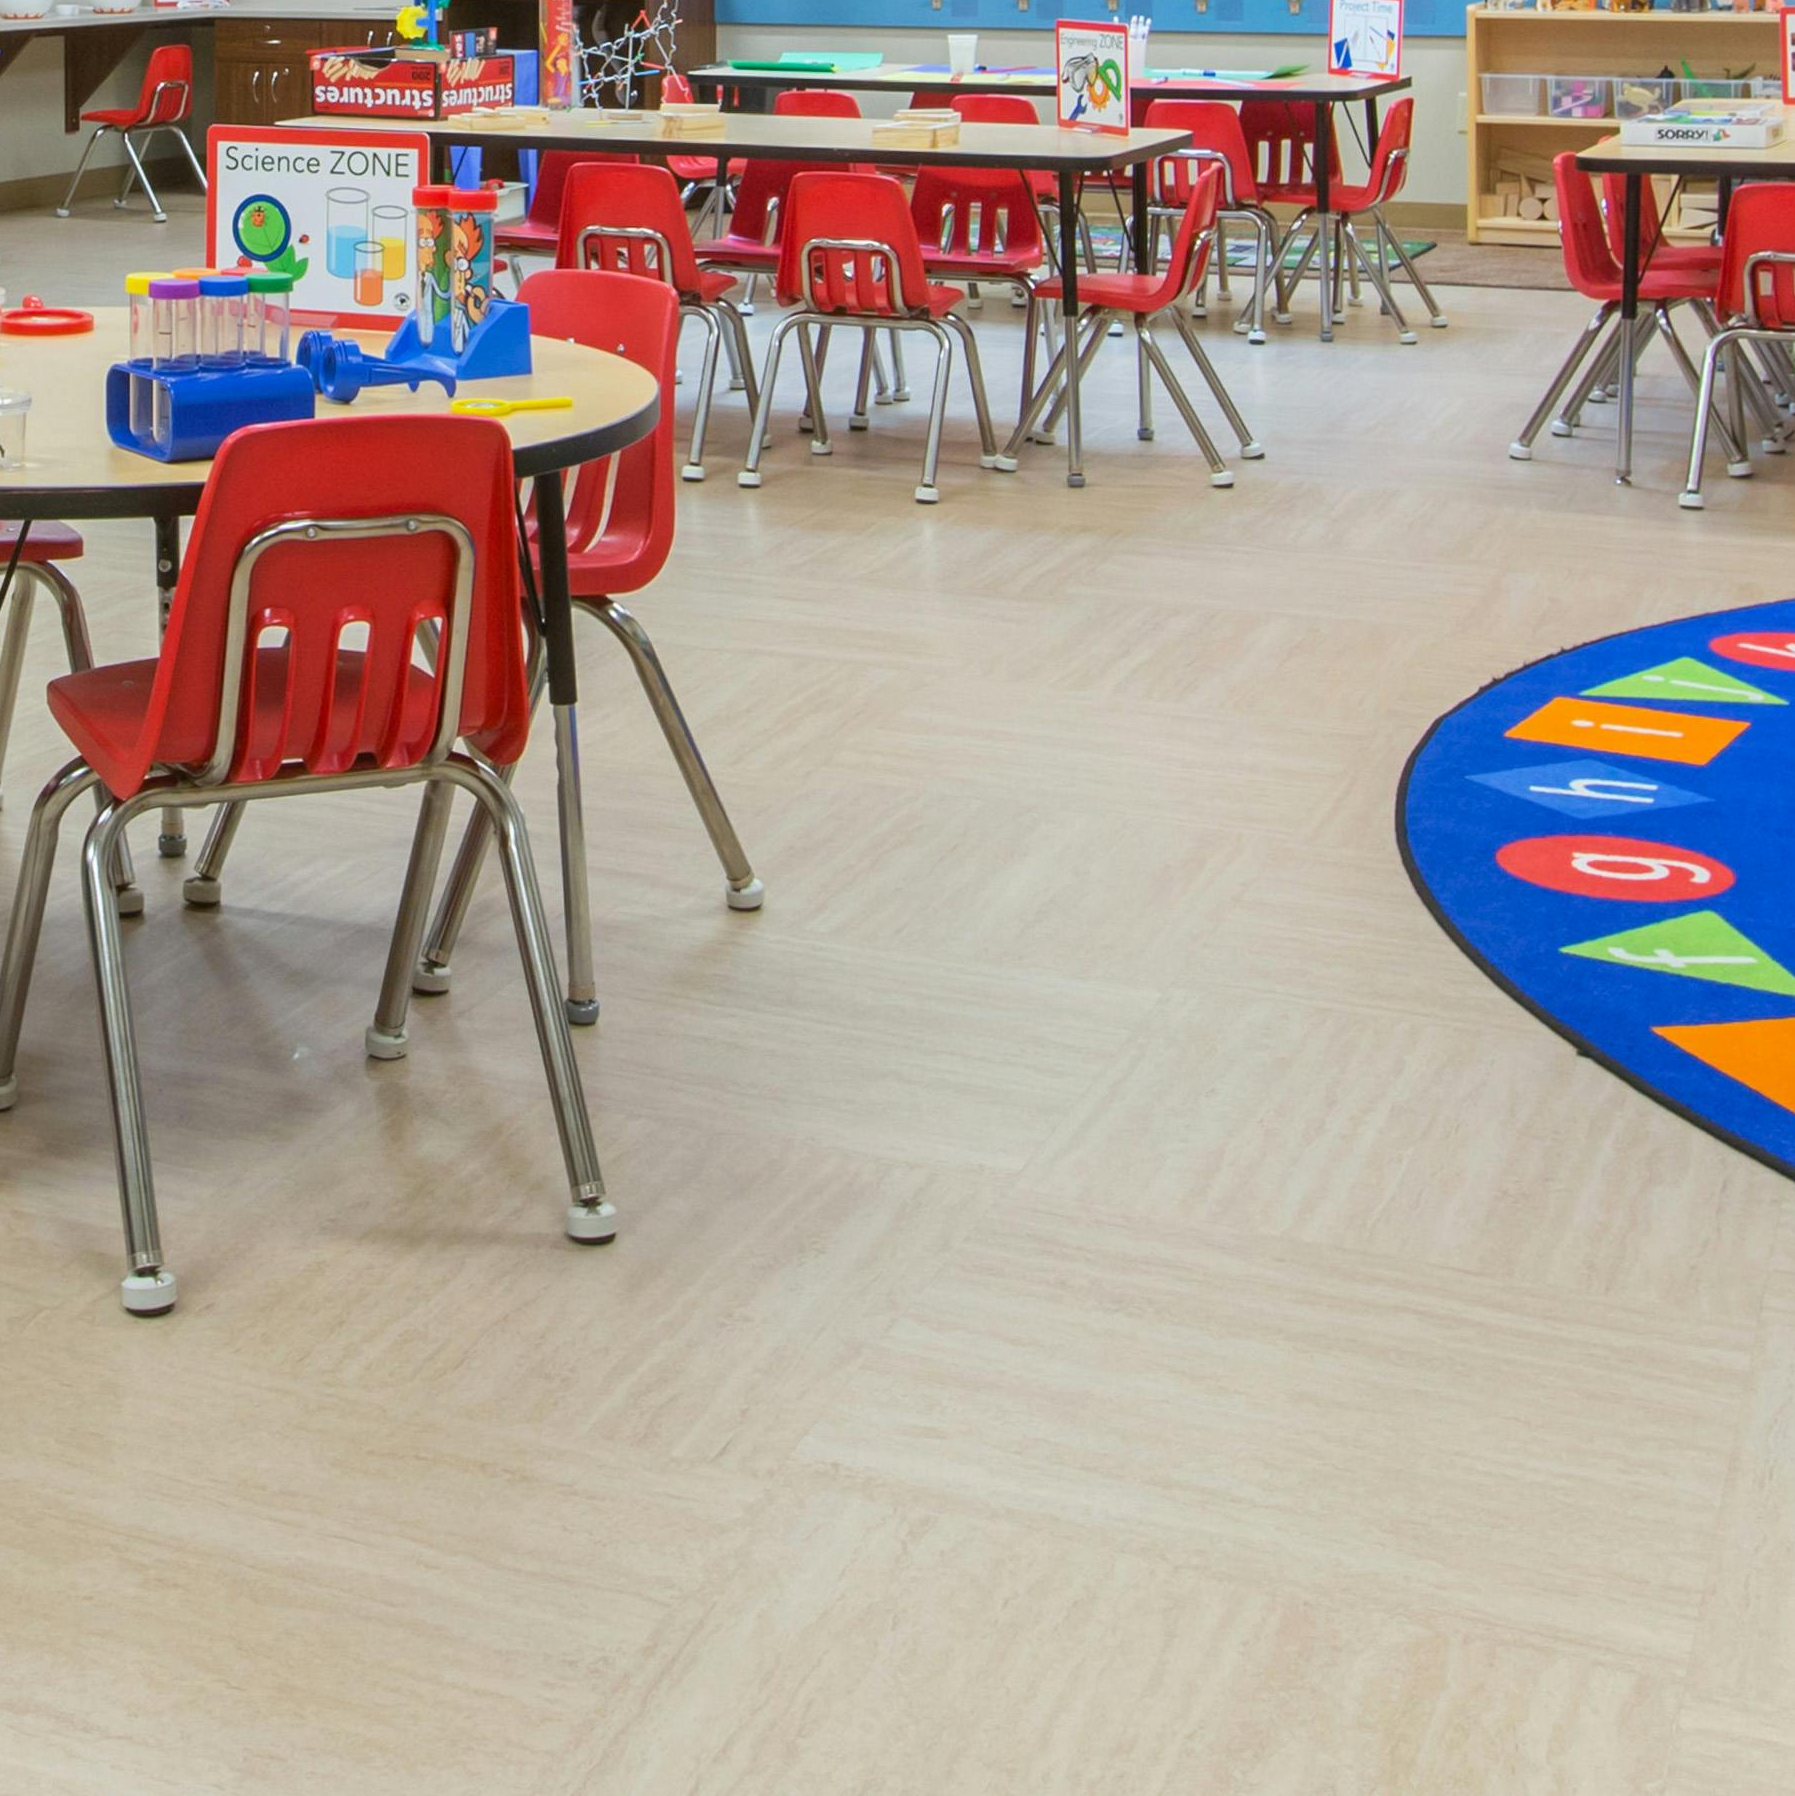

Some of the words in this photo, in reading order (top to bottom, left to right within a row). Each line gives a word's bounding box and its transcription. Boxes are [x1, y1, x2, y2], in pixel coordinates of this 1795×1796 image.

[1339, 0, 1369, 13] Project
[1372, 1, 1393, 13] Time
[1099, 33, 1124, 51] ZONE
[315, 84, 435, 107] structures
[441, 82, 513, 108] structures
[1656, 128, 1709, 141] SORRY!
[225, 145, 321, 174] Science
[329, 150, 410, 178] ZONE
[1642, 675, 1767, 703] j
[1572, 719, 1684, 738] i
[1529, 778, 1660, 804] h
[1570, 850, 1712, 885] g
[1606, 944, 1759, 970] f
